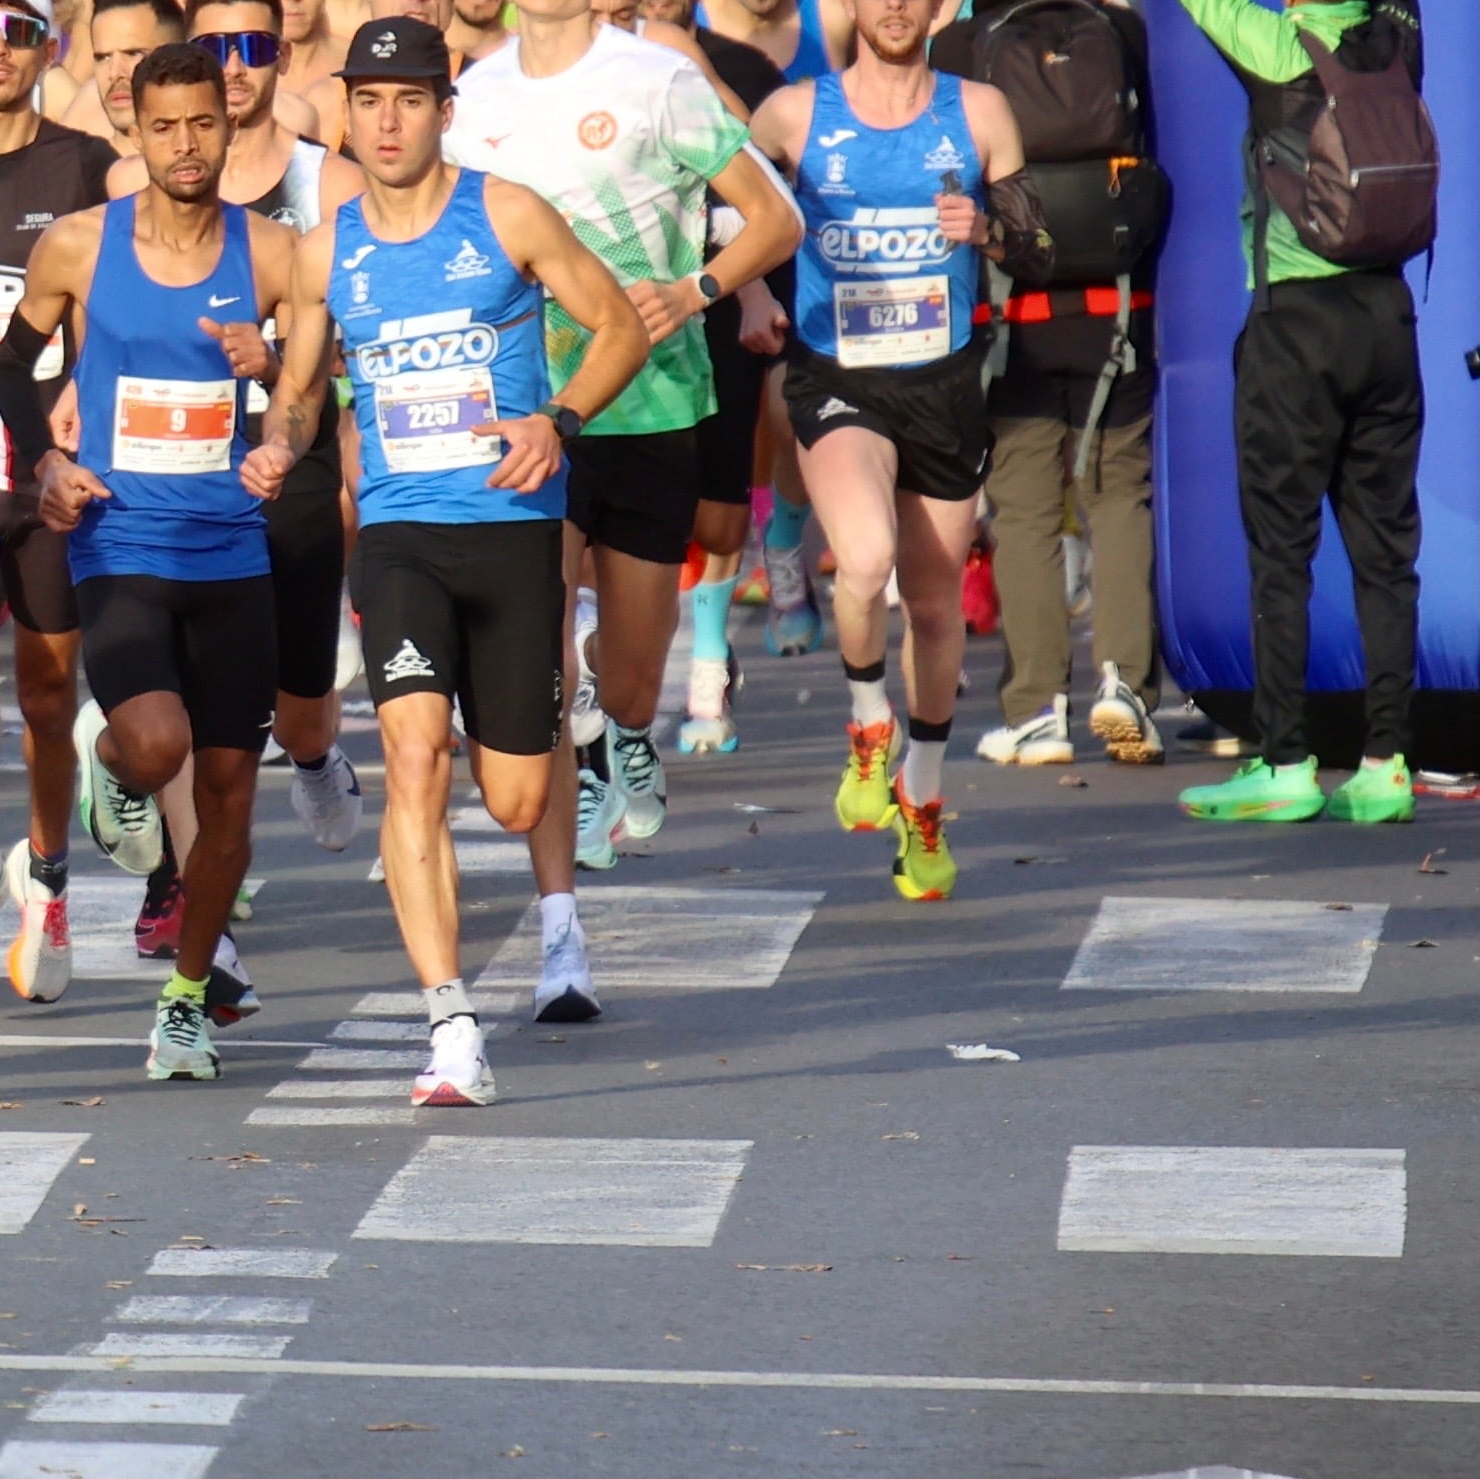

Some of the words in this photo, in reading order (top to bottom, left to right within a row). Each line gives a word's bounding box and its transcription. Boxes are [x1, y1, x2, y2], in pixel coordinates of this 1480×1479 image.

[869, 303, 919, 328] 6276
[169, 408, 187, 433] 9
[406, 401, 460, 429] 2257
